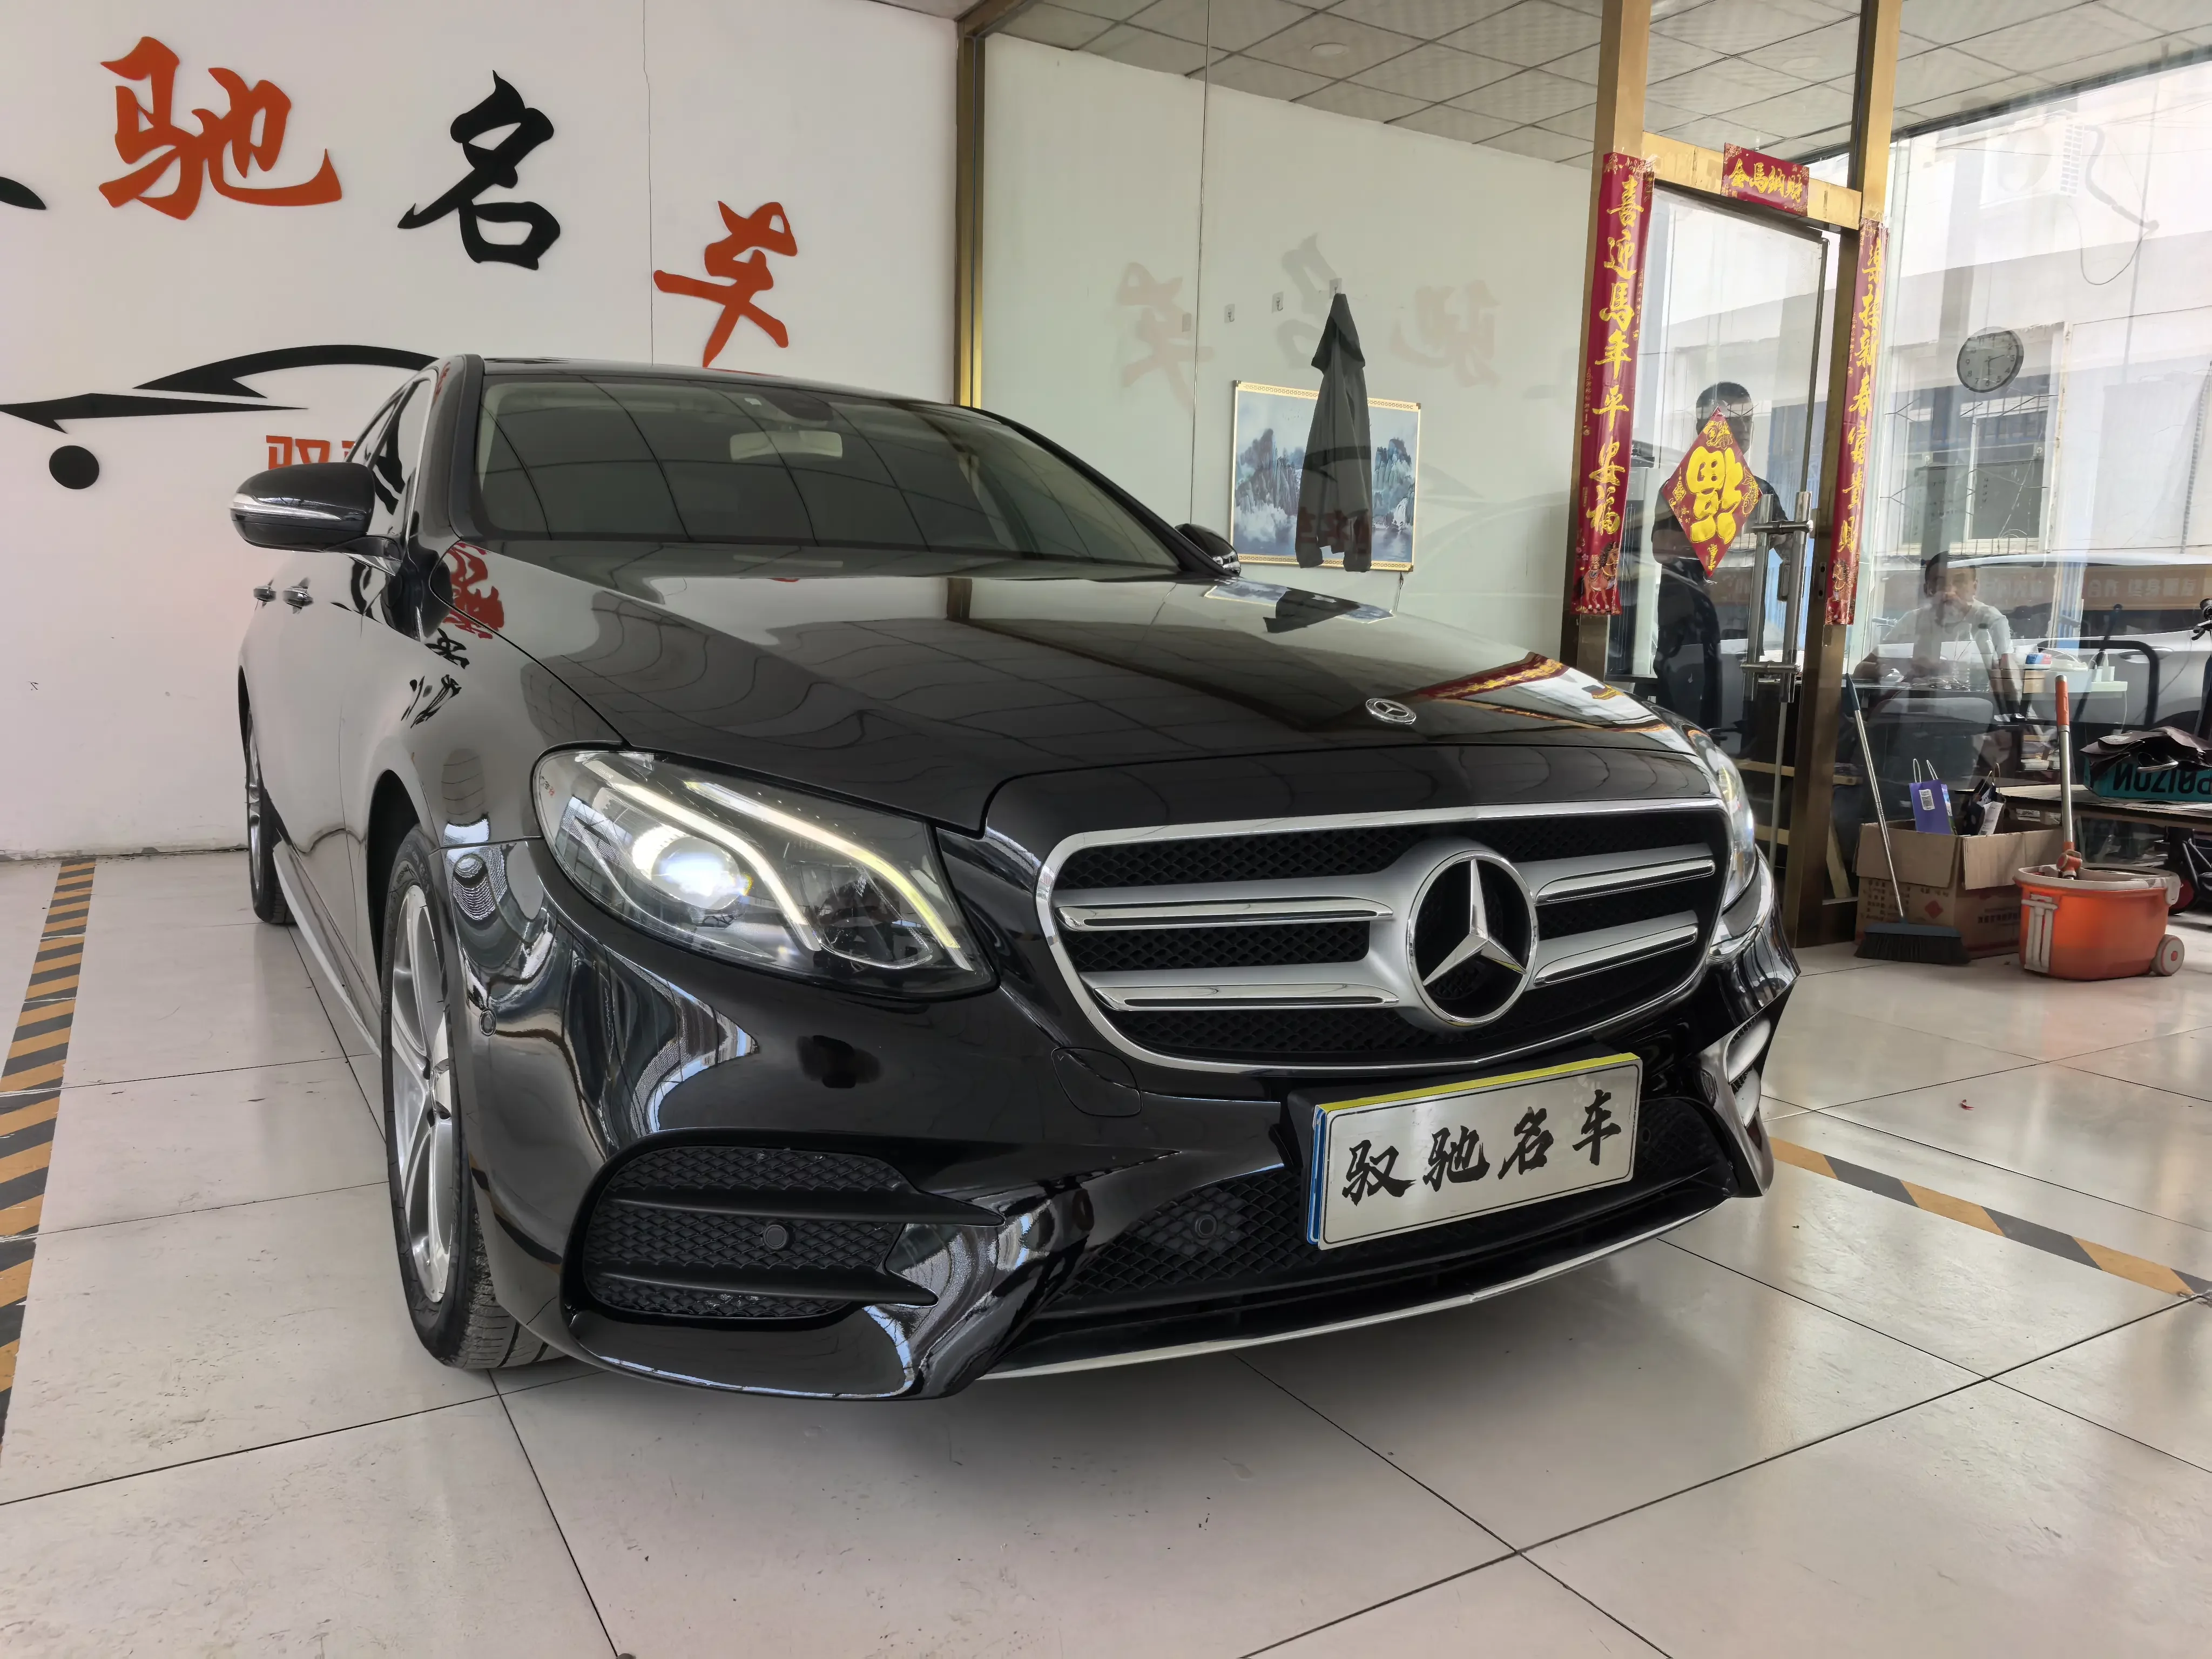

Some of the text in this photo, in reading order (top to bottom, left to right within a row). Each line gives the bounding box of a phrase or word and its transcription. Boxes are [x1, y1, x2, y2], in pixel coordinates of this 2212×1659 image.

[1586, 174, 1644, 535] 喜迎馬年平安福
[1685, 446, 1744, 545] 福
[1342, 1089, 1622, 1206] 驭驰名车
